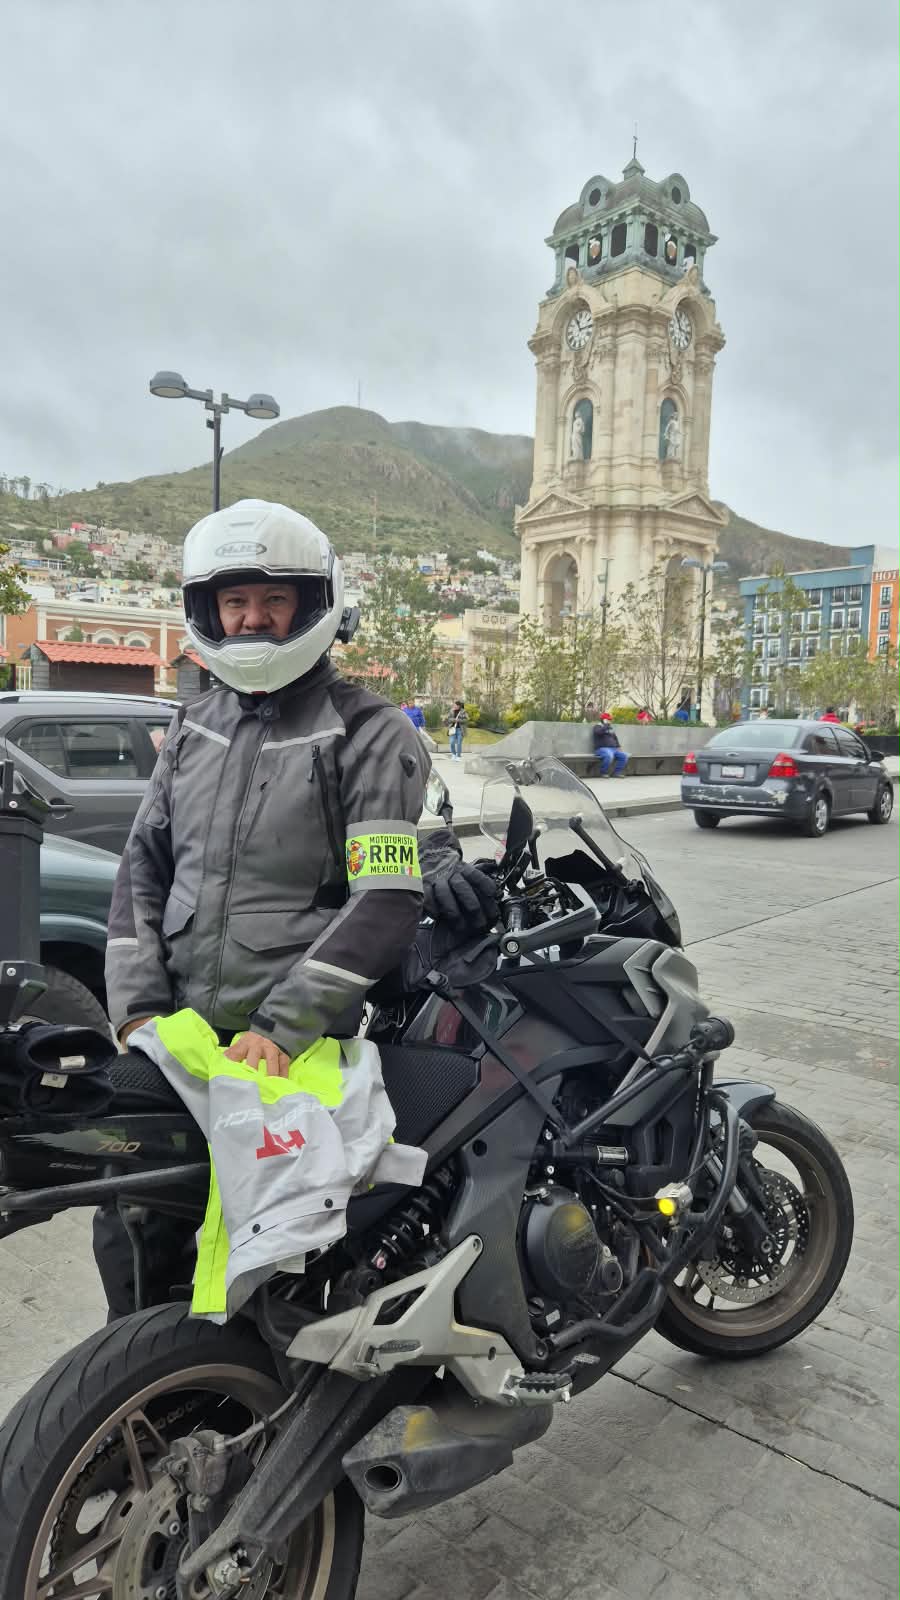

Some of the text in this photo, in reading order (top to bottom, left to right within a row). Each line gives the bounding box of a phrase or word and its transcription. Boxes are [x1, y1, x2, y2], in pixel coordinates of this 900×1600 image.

[369, 836, 413, 845] MOTOTURISTA
[369, 845, 414, 864] RRM
[96, 1141, 141, 1153] 700
